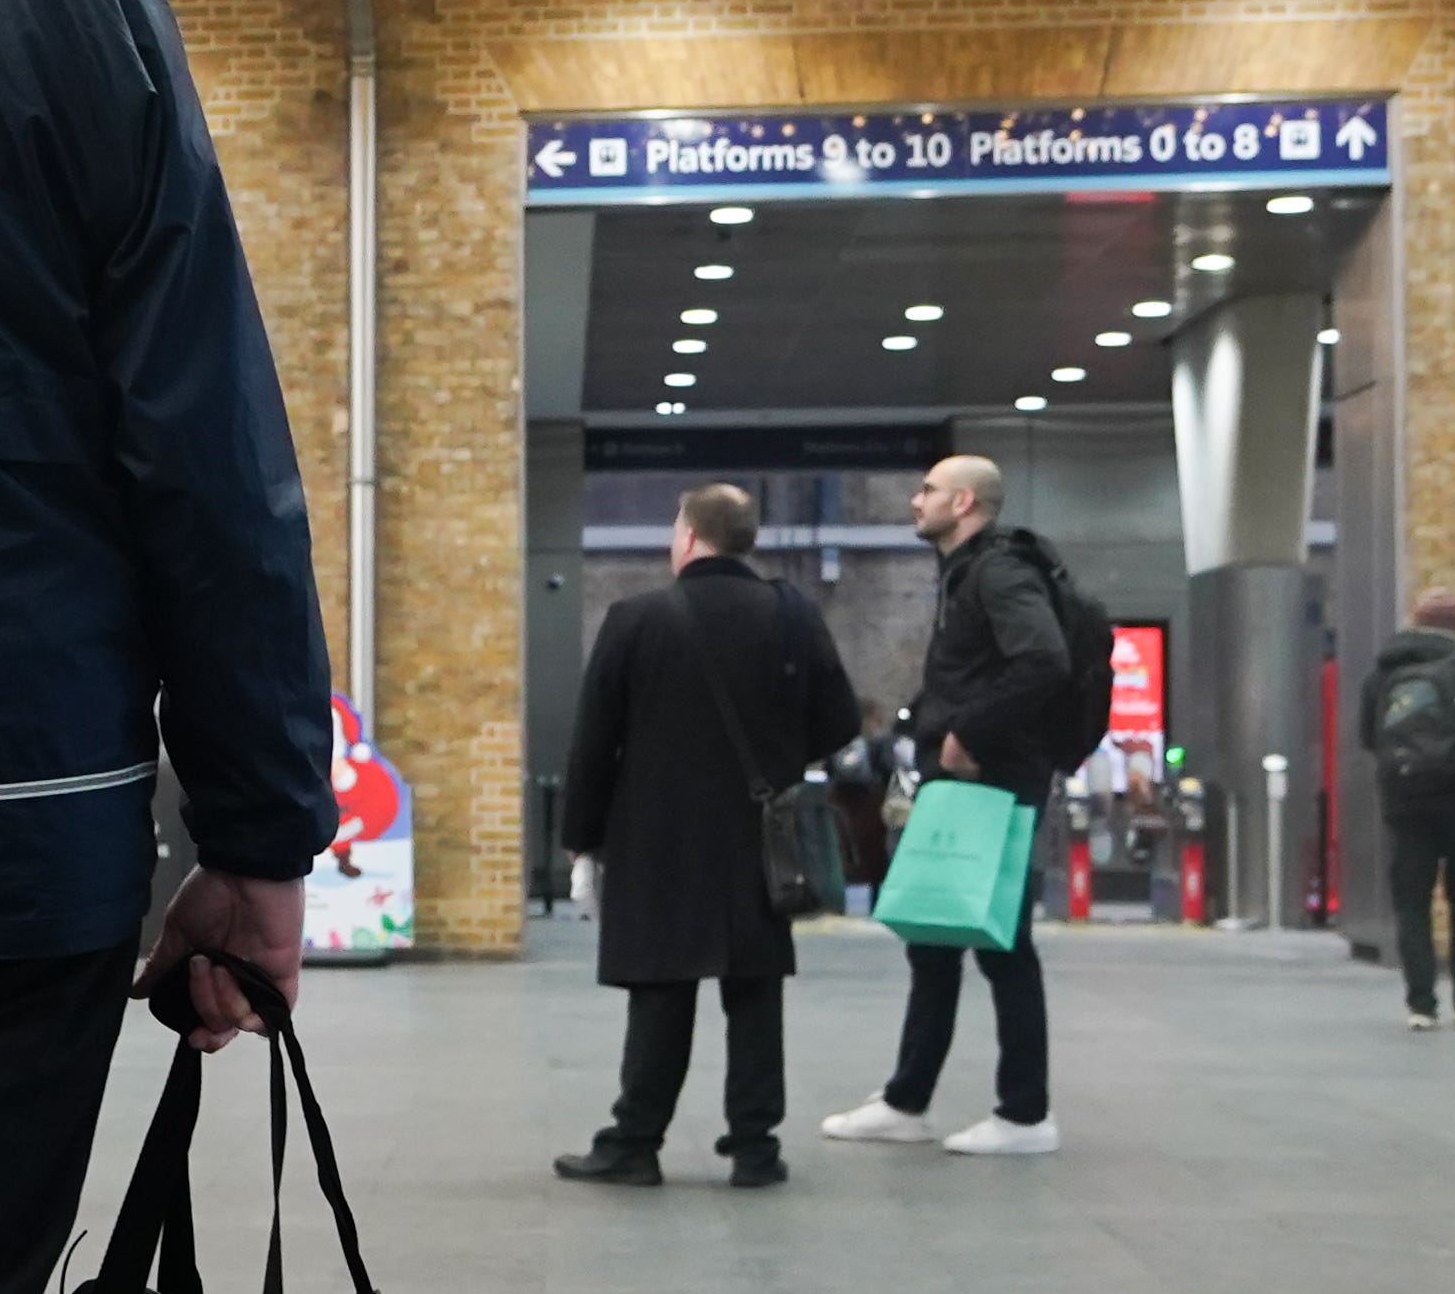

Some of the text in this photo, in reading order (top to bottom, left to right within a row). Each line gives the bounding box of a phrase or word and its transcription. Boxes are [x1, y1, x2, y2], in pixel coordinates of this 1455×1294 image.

[647, 123, 1260, 174] Platforms 9 to 10 Platforms 0 to 8
